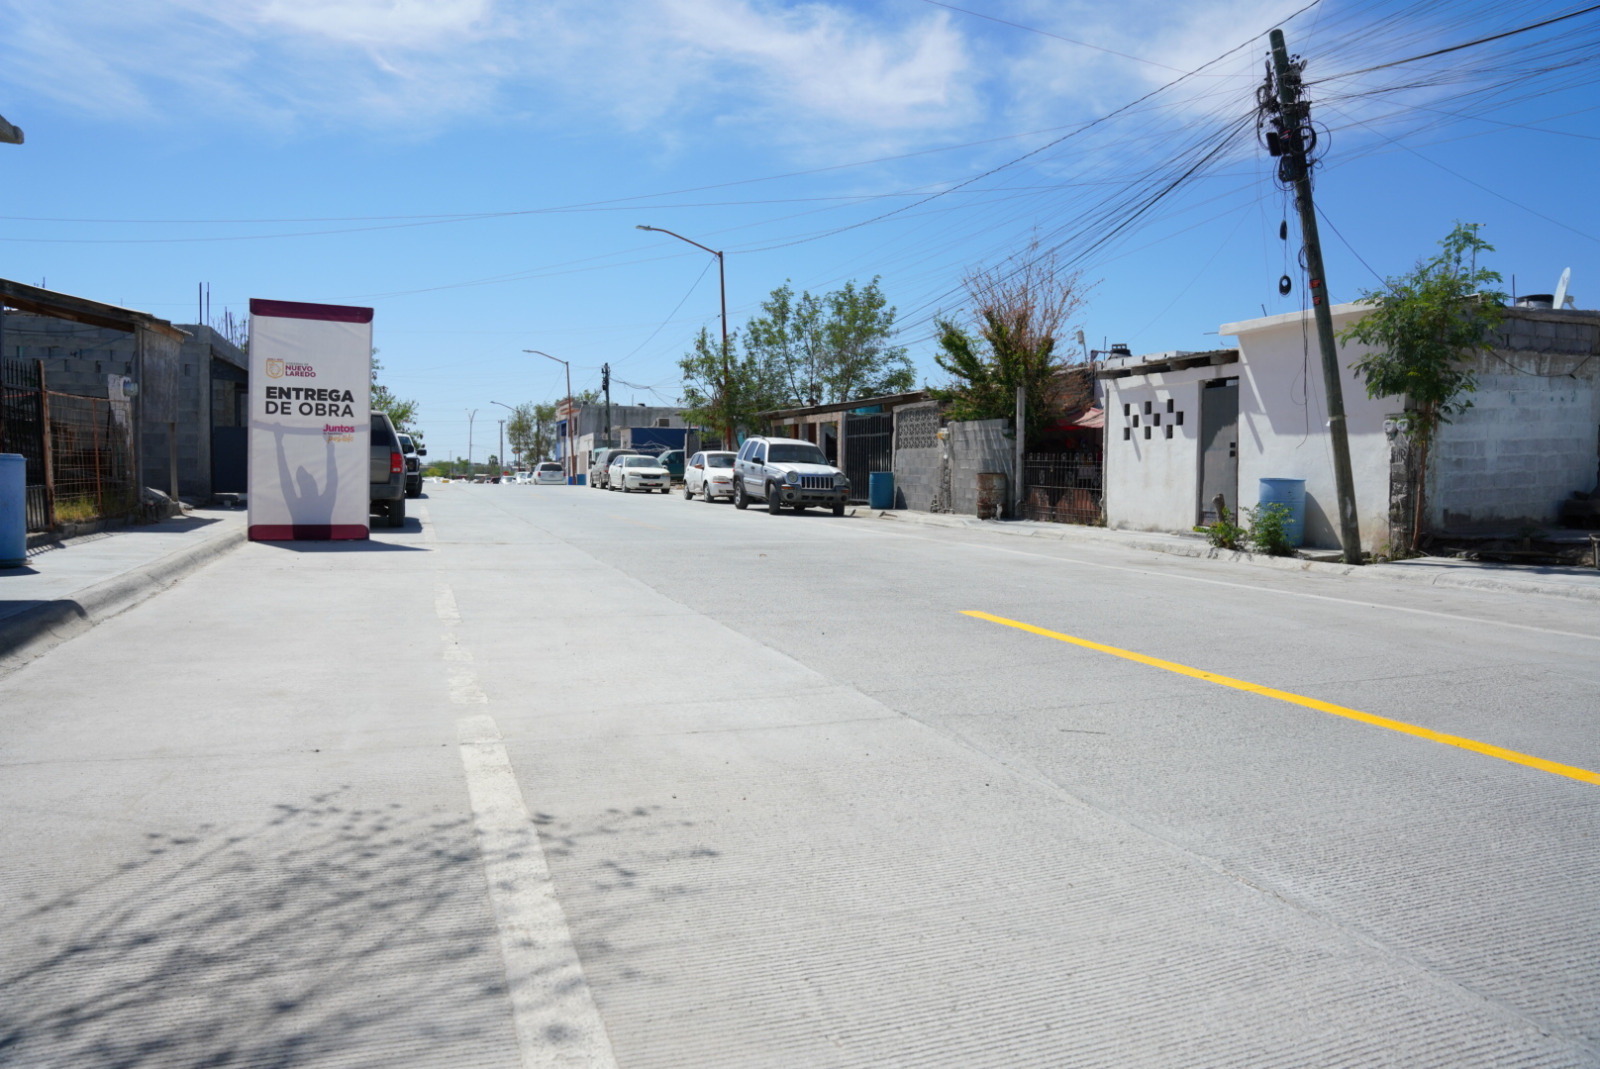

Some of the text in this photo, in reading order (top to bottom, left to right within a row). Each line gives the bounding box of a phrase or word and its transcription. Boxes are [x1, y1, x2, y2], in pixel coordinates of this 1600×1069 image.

[265, 386, 354, 403] ENTREGA
[265, 401, 354, 417] DE OBRA
[323, 424, 355, 433] Juntos
